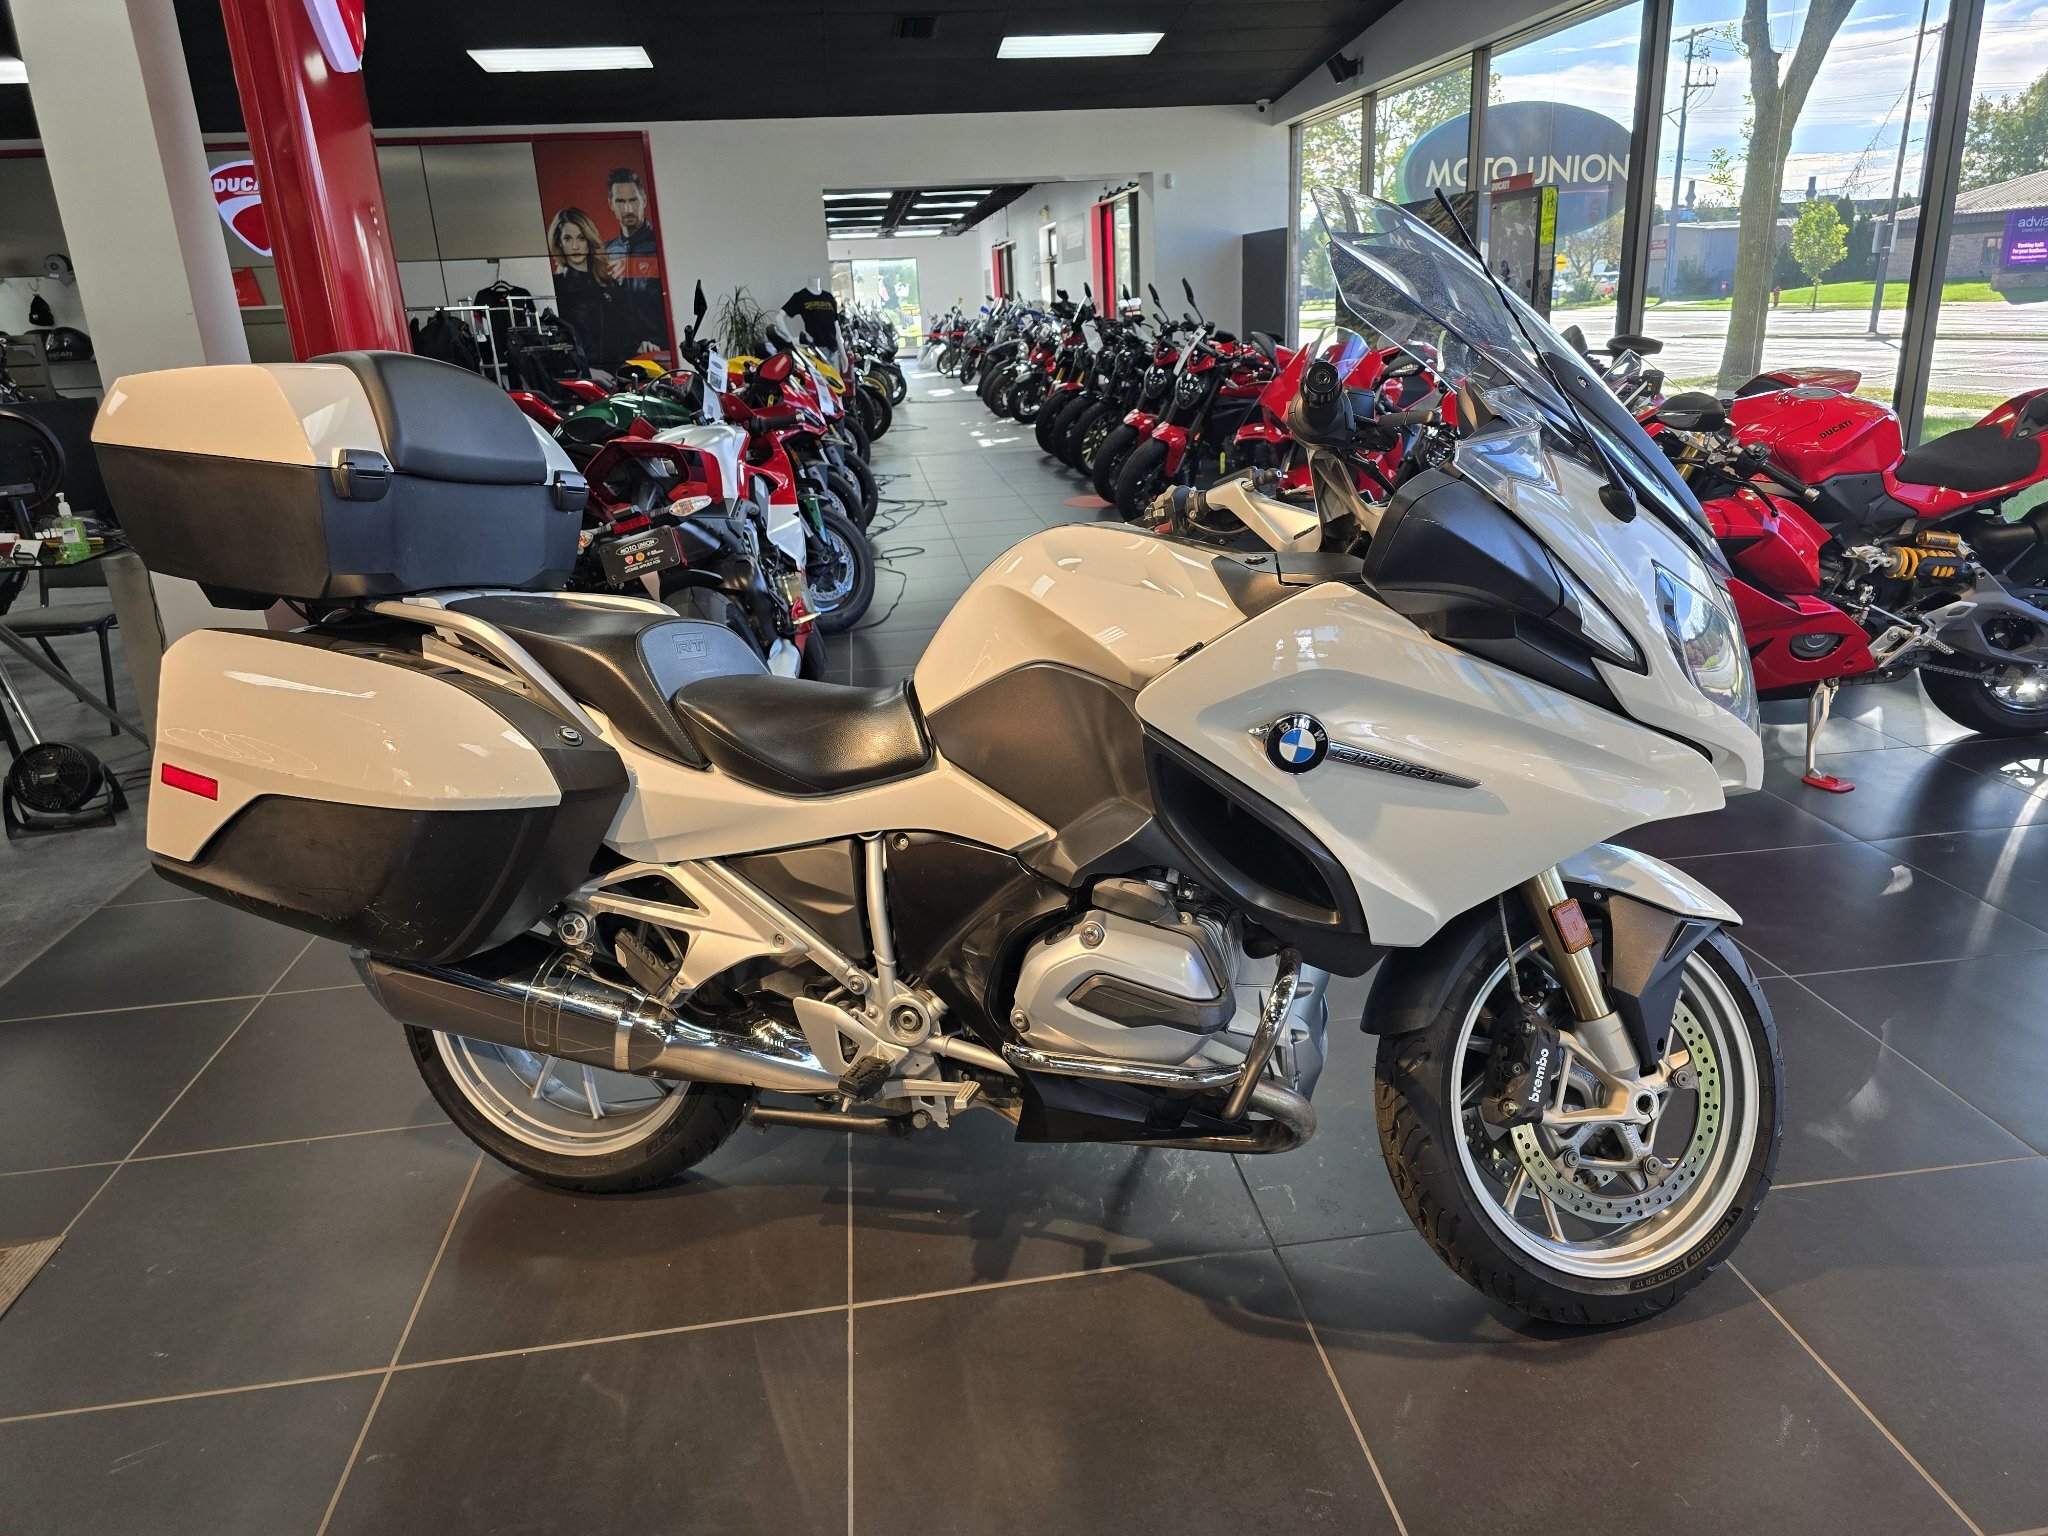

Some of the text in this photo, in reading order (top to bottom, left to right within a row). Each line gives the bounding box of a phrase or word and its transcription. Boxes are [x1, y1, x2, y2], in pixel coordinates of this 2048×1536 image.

[1527, 153, 1631, 184] UNION
[213, 176, 260, 193] DUC
[2017, 215, 2048, 228] advia
[1819, 420, 1853, 439] DUCATI
[620, 545, 638, 555] MOTO
[638, 539, 655, 551] UNION
[1279, 718, 1327, 743] BMW
[1528, 1048, 1549, 1103] brembo
[1690, 1222, 1730, 1264] MICHELIN
[1657, 1263, 1686, 1282] 120/70
